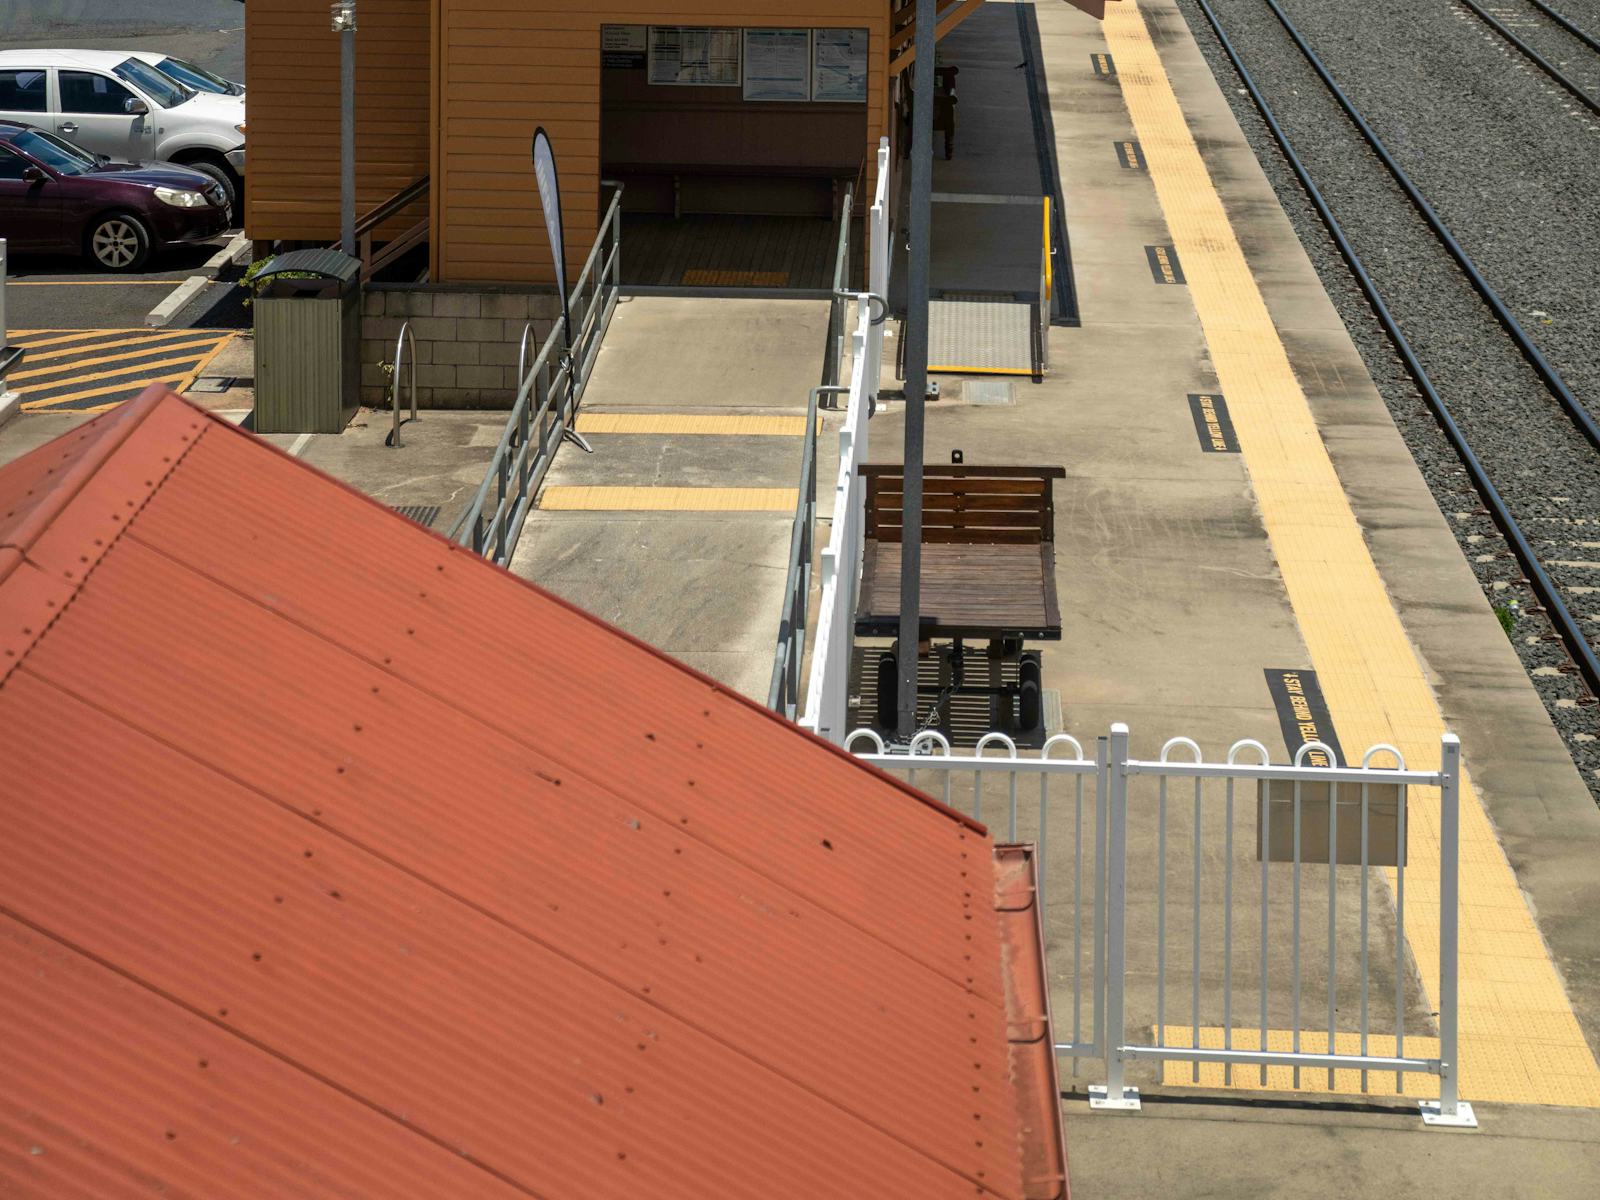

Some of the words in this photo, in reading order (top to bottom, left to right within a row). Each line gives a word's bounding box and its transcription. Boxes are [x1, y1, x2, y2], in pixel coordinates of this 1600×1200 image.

[1283, 678, 1304, 696] STAY
[1289, 695, 1313, 720] BEHIND
[1297, 722, 1321, 744] YELLO
[1308, 751, 1329, 767] LINE
